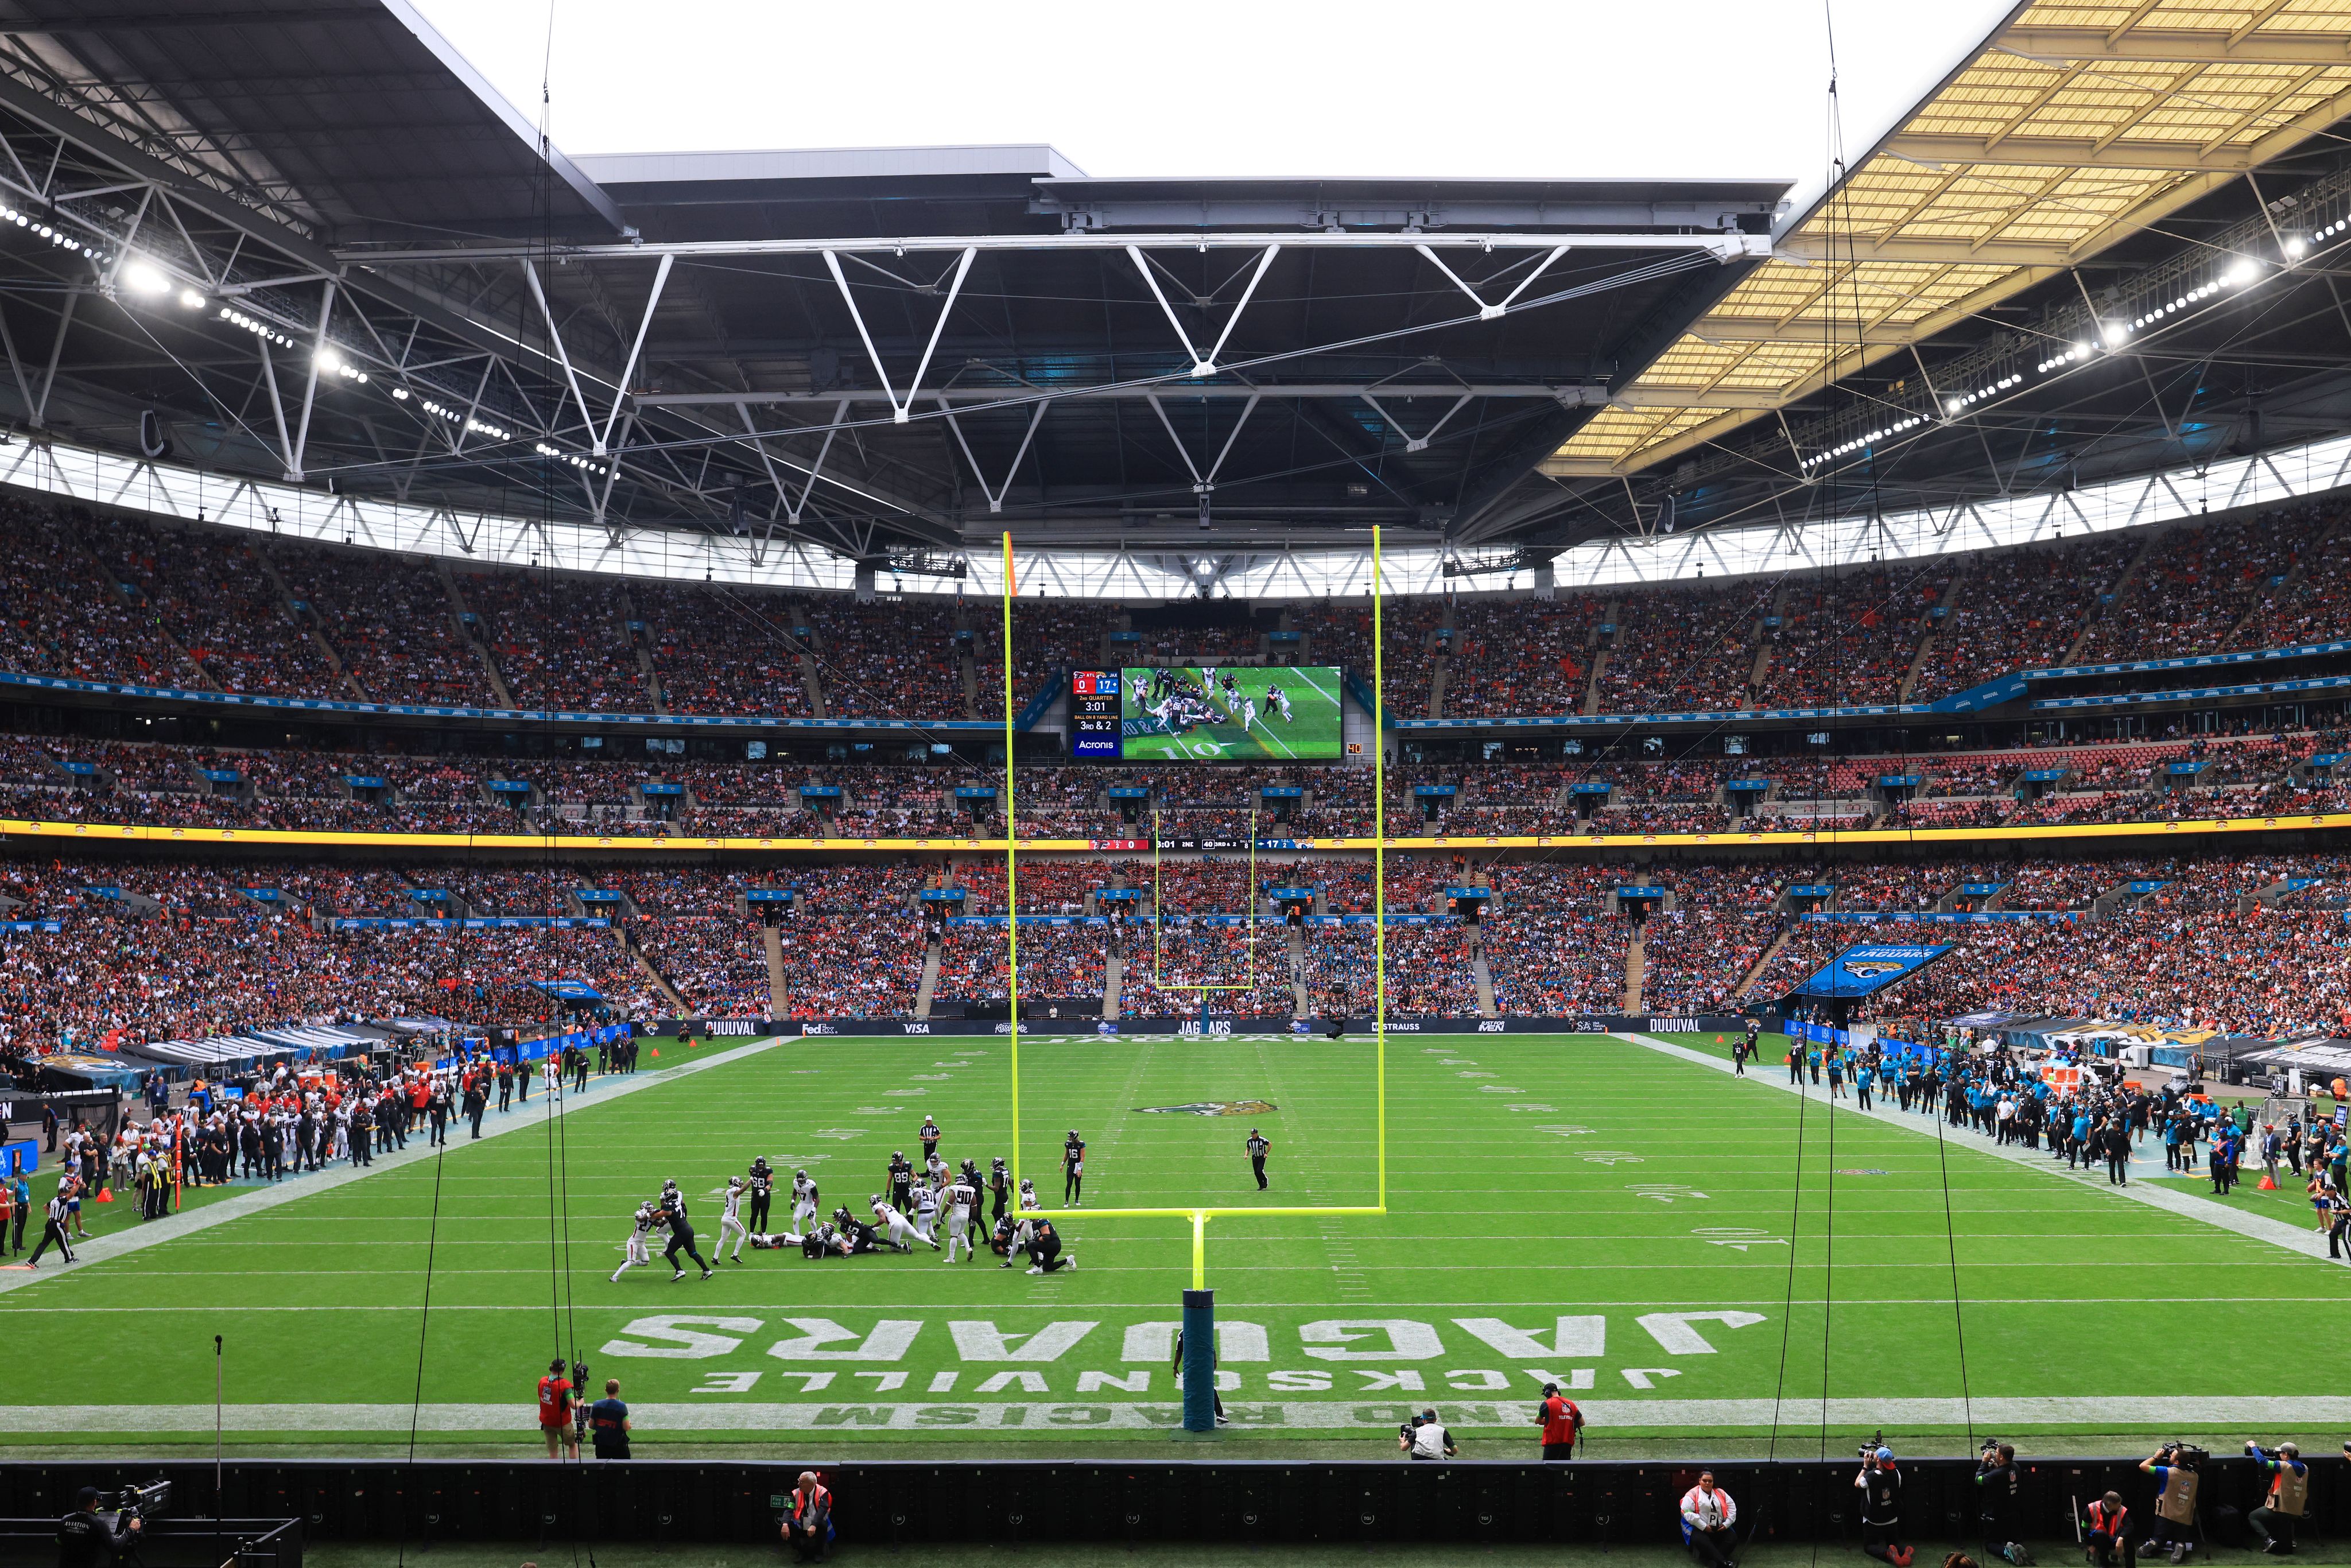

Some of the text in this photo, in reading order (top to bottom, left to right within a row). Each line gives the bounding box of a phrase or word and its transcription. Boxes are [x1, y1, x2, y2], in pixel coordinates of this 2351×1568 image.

[1079, 680, 1085, 689] 0
[1100, 681, 1111, 689] 17
[1983, 691, 1998, 700] DUUUVAL
[1086, 702, 1105, 711] 3:01
[1080, 721, 1111, 730] 3RD & 2
[1079, 740, 1114, 749] Acronis
[1349, 744, 1361, 753] 40
[1128, 841, 1135, 849] 0
[802, 1023, 835, 1034] FedEx
[903, 1024, 930, 1033] VISA
[1178, 1021, 1231, 1034] JAGARS
[1650, 1018, 1701, 1033] DUUUVAL
[562, 1037, 571, 1047] USA
[1880, 1039, 1888, 1052] USA
[522, 1045, 530, 1056] USA
[1925, 1047, 1933, 1060] USA
[1069, 1148, 1078, 1159] 16
[894, 1172, 909, 1183] 89
[923, 1190, 933, 1202] 97
[956, 1190, 972, 1205] 90
[600, 1309, 1768, 1362] JAGUARS
[596, 1418, 616, 1429] ESPN
[1709, 1515, 1716, 1523] P
[64, 1521, 90, 1530] AVIATION
